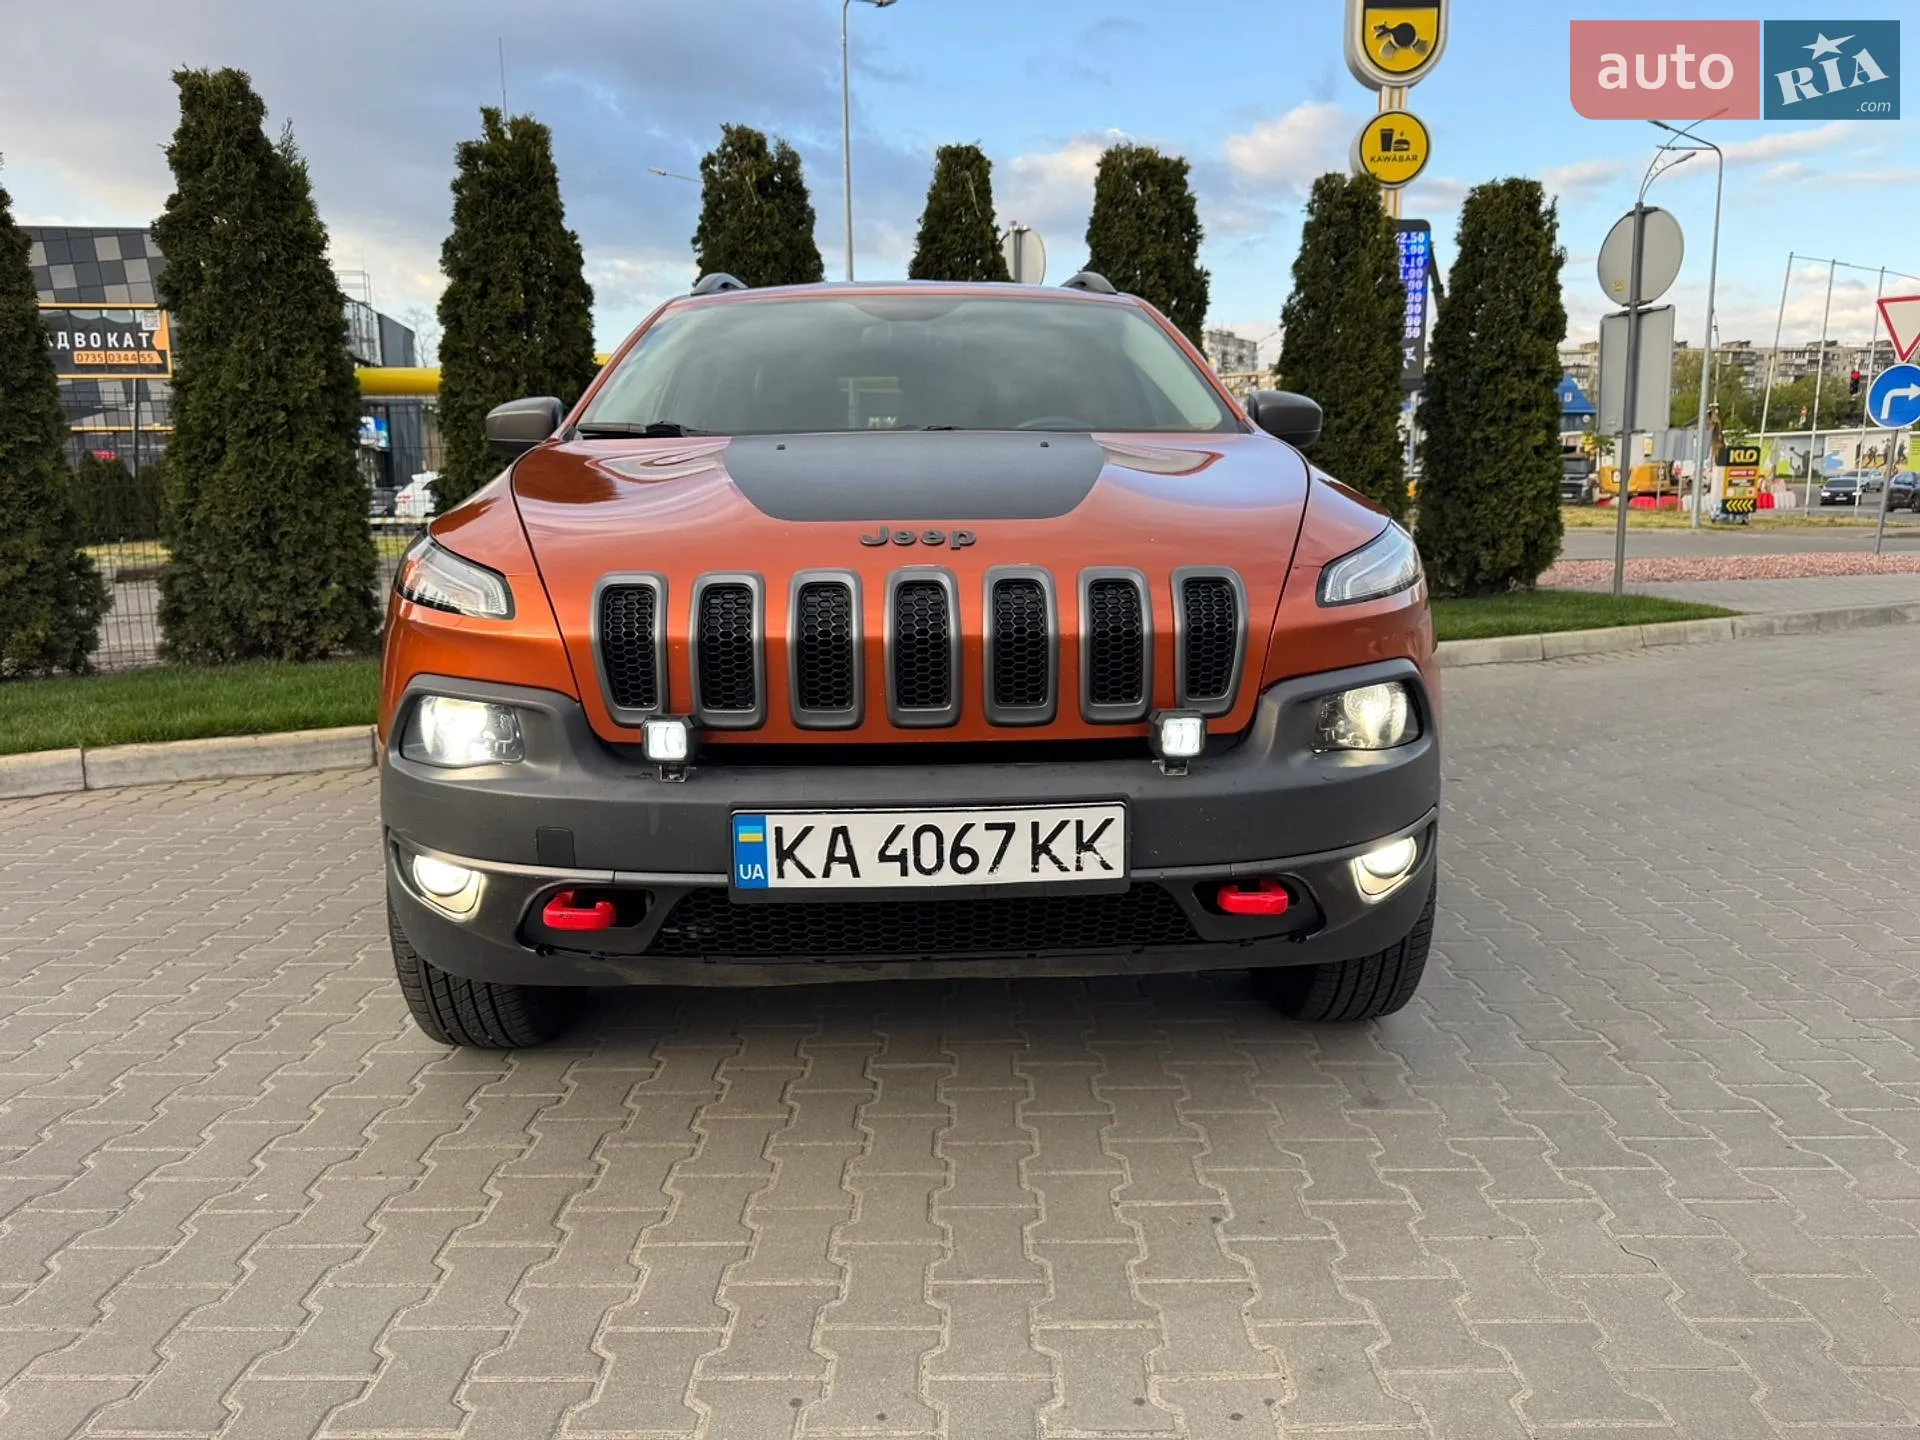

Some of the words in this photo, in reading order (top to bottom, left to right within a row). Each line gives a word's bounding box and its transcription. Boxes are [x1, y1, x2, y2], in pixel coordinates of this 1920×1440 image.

[1398, 244, 1425, 256] 5.90
[1398, 256, 1424, 268] 3.10
[1398, 268, 1423, 280] 1.90
[1729, 449, 1758, 463] KLO
[860, 526, 977, 550] Jeep
[774, 825, 861, 880] KA
[877, 822, 1017, 877] 4067
[1030, 817, 1116, 873] KK
[739, 863, 765, 881] UA
